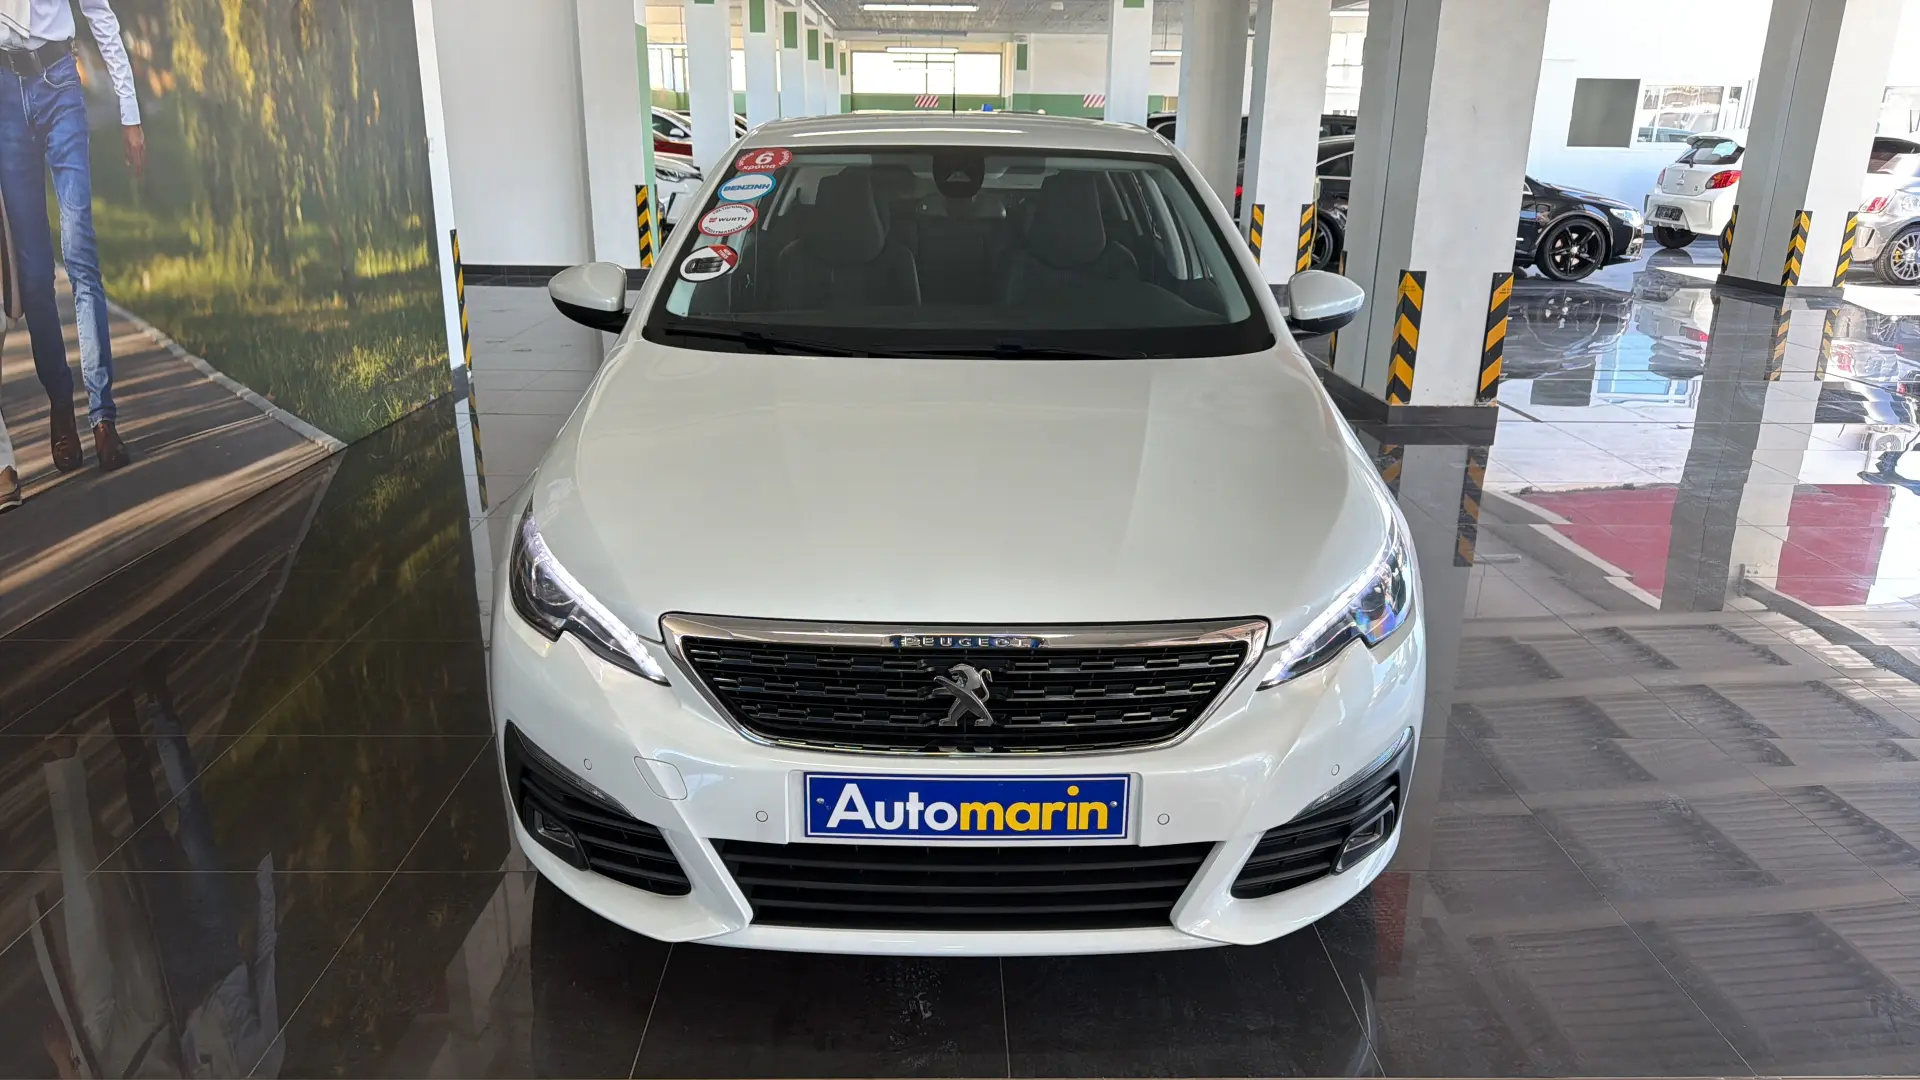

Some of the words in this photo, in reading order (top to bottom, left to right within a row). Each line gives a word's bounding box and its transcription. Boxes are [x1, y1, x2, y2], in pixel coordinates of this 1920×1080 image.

[755, 151, 775, 165] 6
[901, 635, 1030, 648] PEUGEOT
[826, 782, 1109, 832] Automarin
